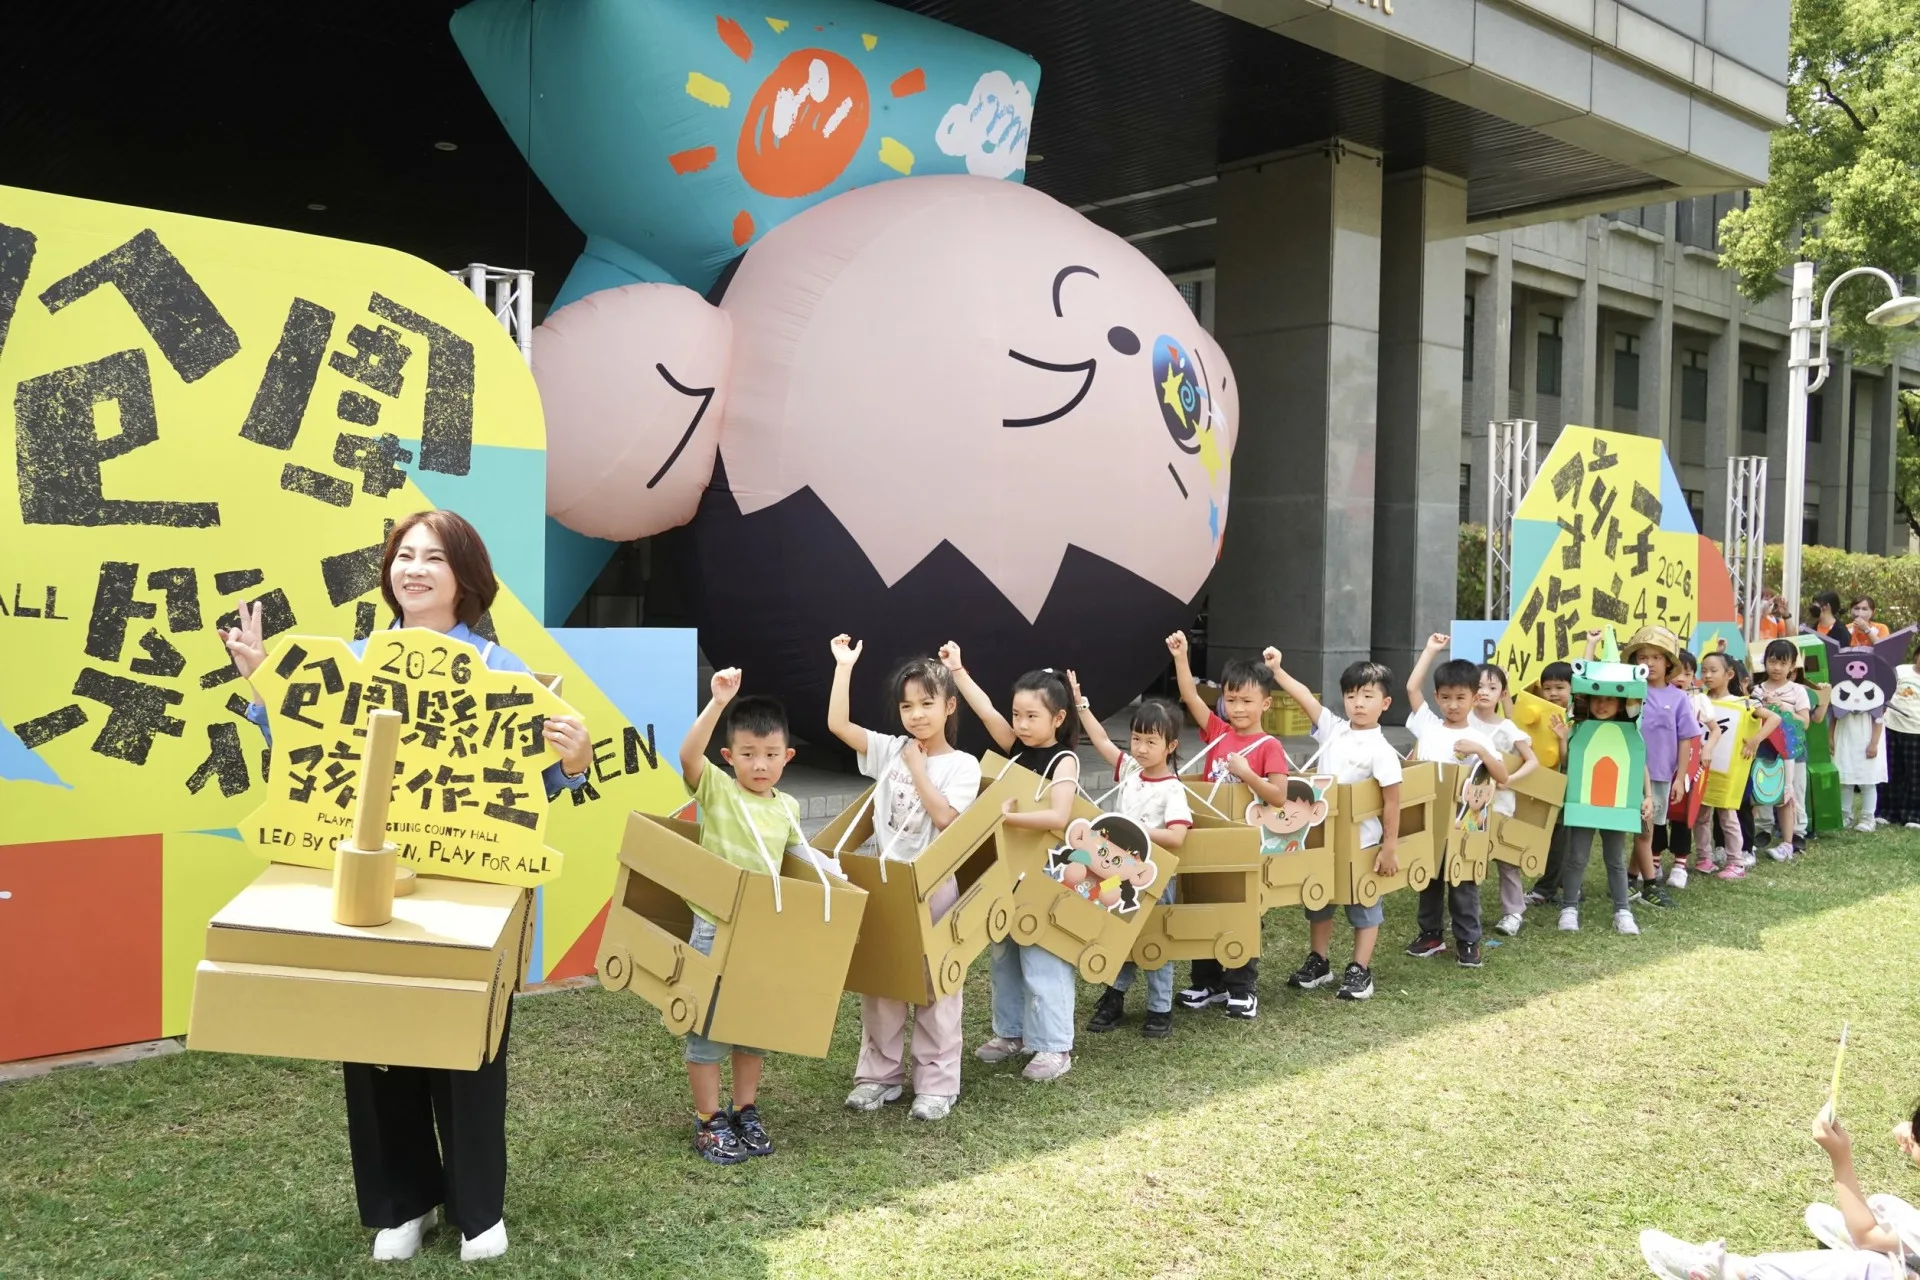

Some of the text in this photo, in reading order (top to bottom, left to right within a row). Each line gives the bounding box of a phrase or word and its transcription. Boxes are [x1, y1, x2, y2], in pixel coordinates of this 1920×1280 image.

[1655, 556, 1693, 600] 2026.
[380, 641, 472, 684] 2026
[275, 643, 551, 759] 包圍縣府
[288, 740, 539, 831] 孩作主
[259, 827, 297, 846] LED
[481, 852, 511, 872] FOR
[515, 856, 551, 873] ALL
[317, 812, 500, 844] PLAYF GTUNG COUNTY HALL
